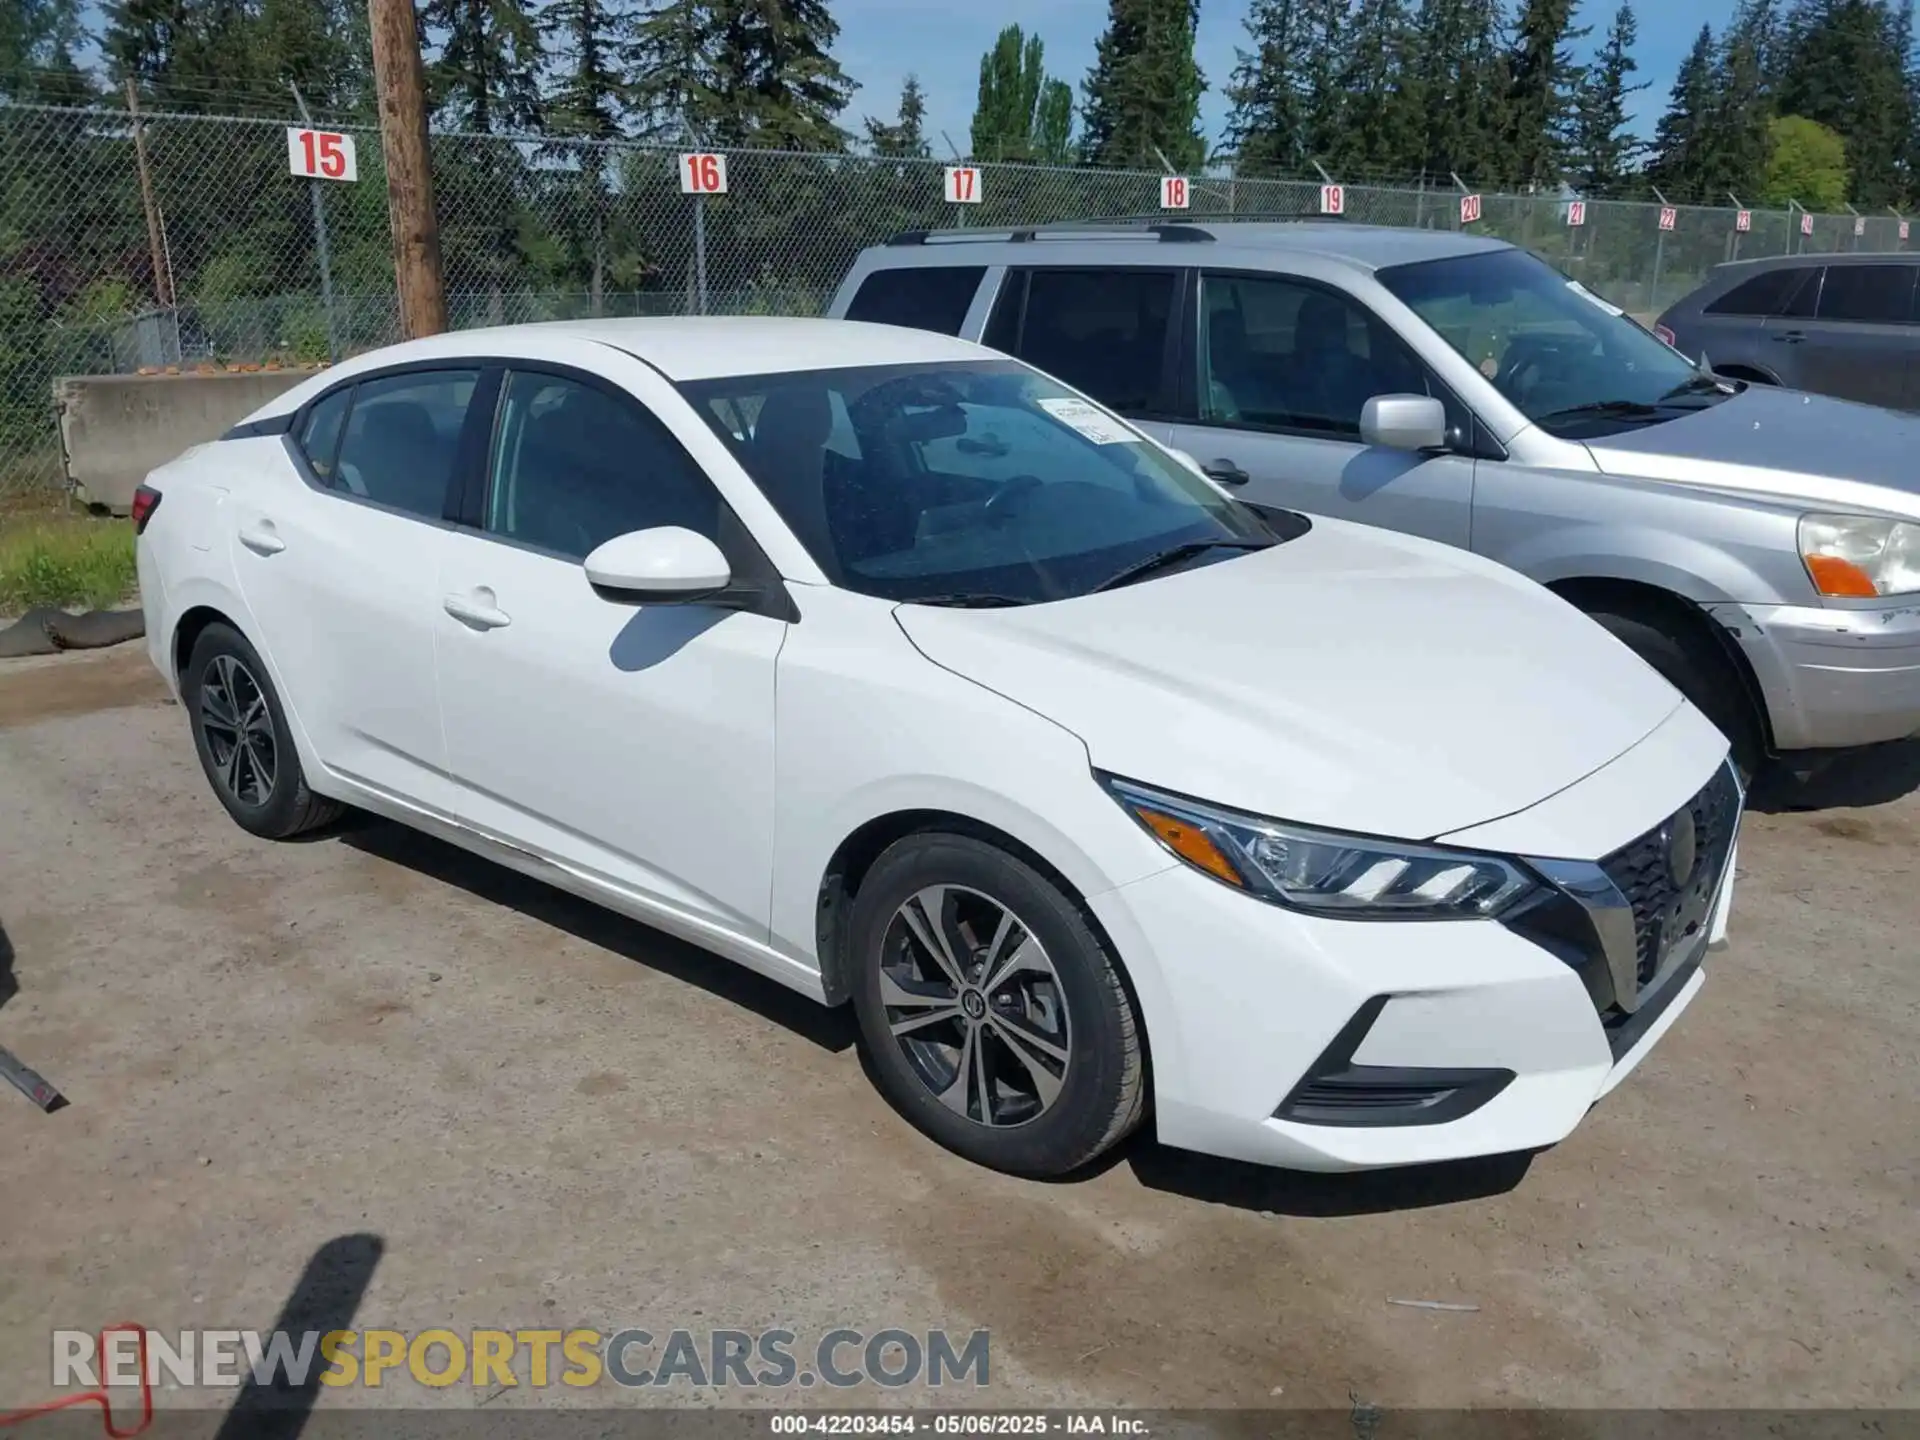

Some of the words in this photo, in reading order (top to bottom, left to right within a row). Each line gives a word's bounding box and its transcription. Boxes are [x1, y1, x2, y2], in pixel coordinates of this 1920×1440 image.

[298, 130, 346, 178] 15
[687, 154, 721, 193] 16
[952, 168, 976, 200] 17
[1165, 179, 1186, 206] 18
[1325, 186, 1341, 212] 19
[1461, 197, 1479, 221] 20
[1570, 203, 1583, 224] 21
[1661, 209, 1674, 228] 22
